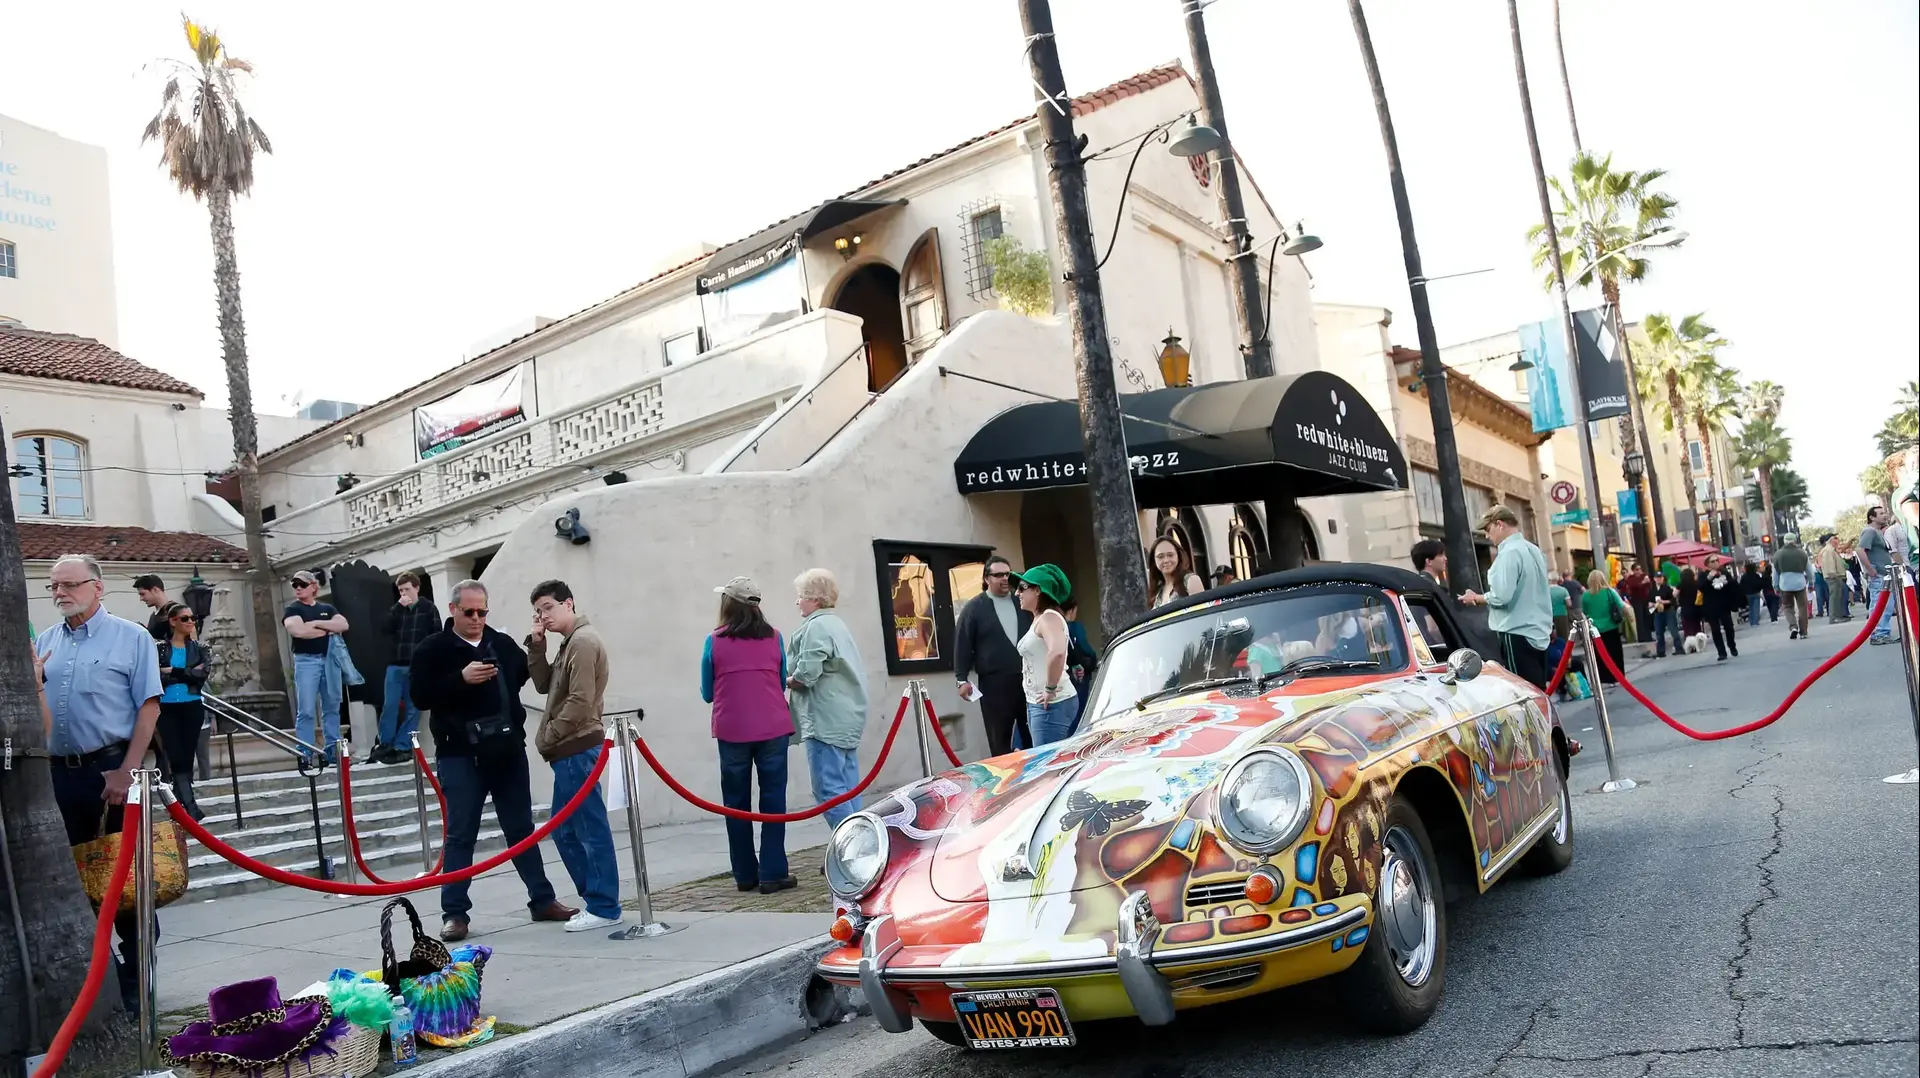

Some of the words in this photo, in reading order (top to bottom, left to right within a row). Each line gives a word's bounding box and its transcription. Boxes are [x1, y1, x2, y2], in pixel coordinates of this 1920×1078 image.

[0, 161, 18, 176] e
[701, 272, 727, 288] Carrie
[727, 257, 765, 278] Hamilton
[1588, 394, 1627, 409] PLAYHOUSE
[1296, 423, 1389, 462] redwhite+bluezz
[1328, 452, 1347, 469] JAZZ
[1349, 458, 1368, 473] CLUB
[975, 993, 1005, 1001] BEVERLY
[1007, 991, 1029, 1000] HILLS
[981, 999, 1030, 1009] CALIFORNIA
[964, 1011, 1017, 1040] VAN
[1017, 1009, 1064, 1038] 990
[972, 1037, 1070, 1049] ESTES-ZIPPER
